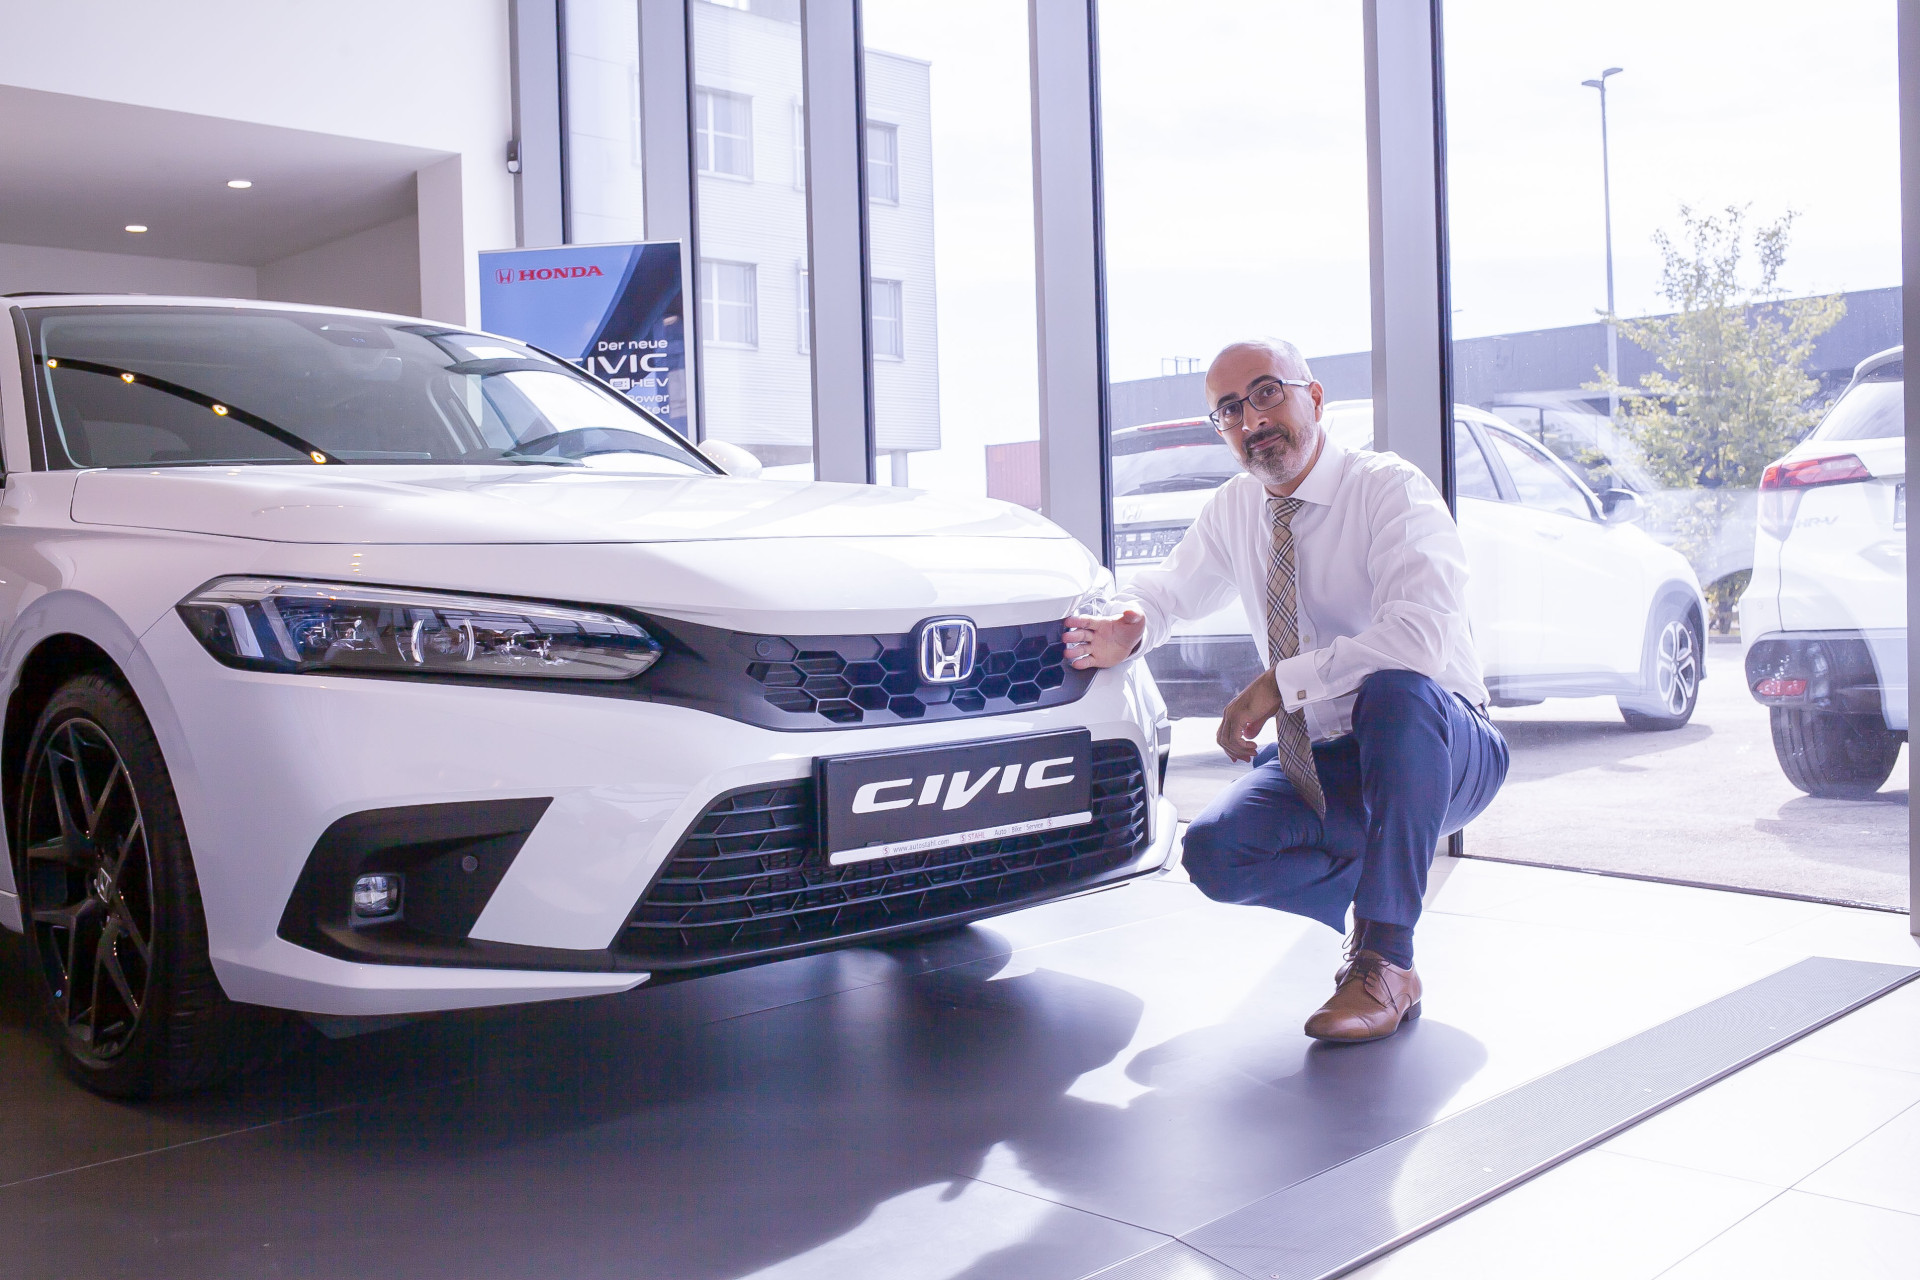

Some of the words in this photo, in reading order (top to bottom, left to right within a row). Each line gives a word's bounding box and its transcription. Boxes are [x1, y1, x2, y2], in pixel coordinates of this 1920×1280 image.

[518, 265, 604, 282] HONDA
[598, 341, 625, 352] Der
[628, 339, 668, 350] neue
[564, 353, 669, 375] IVIC
[852, 756, 1075, 814] CIVIC
[967, 831, 985, 841] STAHL
[995, 828, 1007, 836] Auto
[1026, 822, 1043, 830] Service
